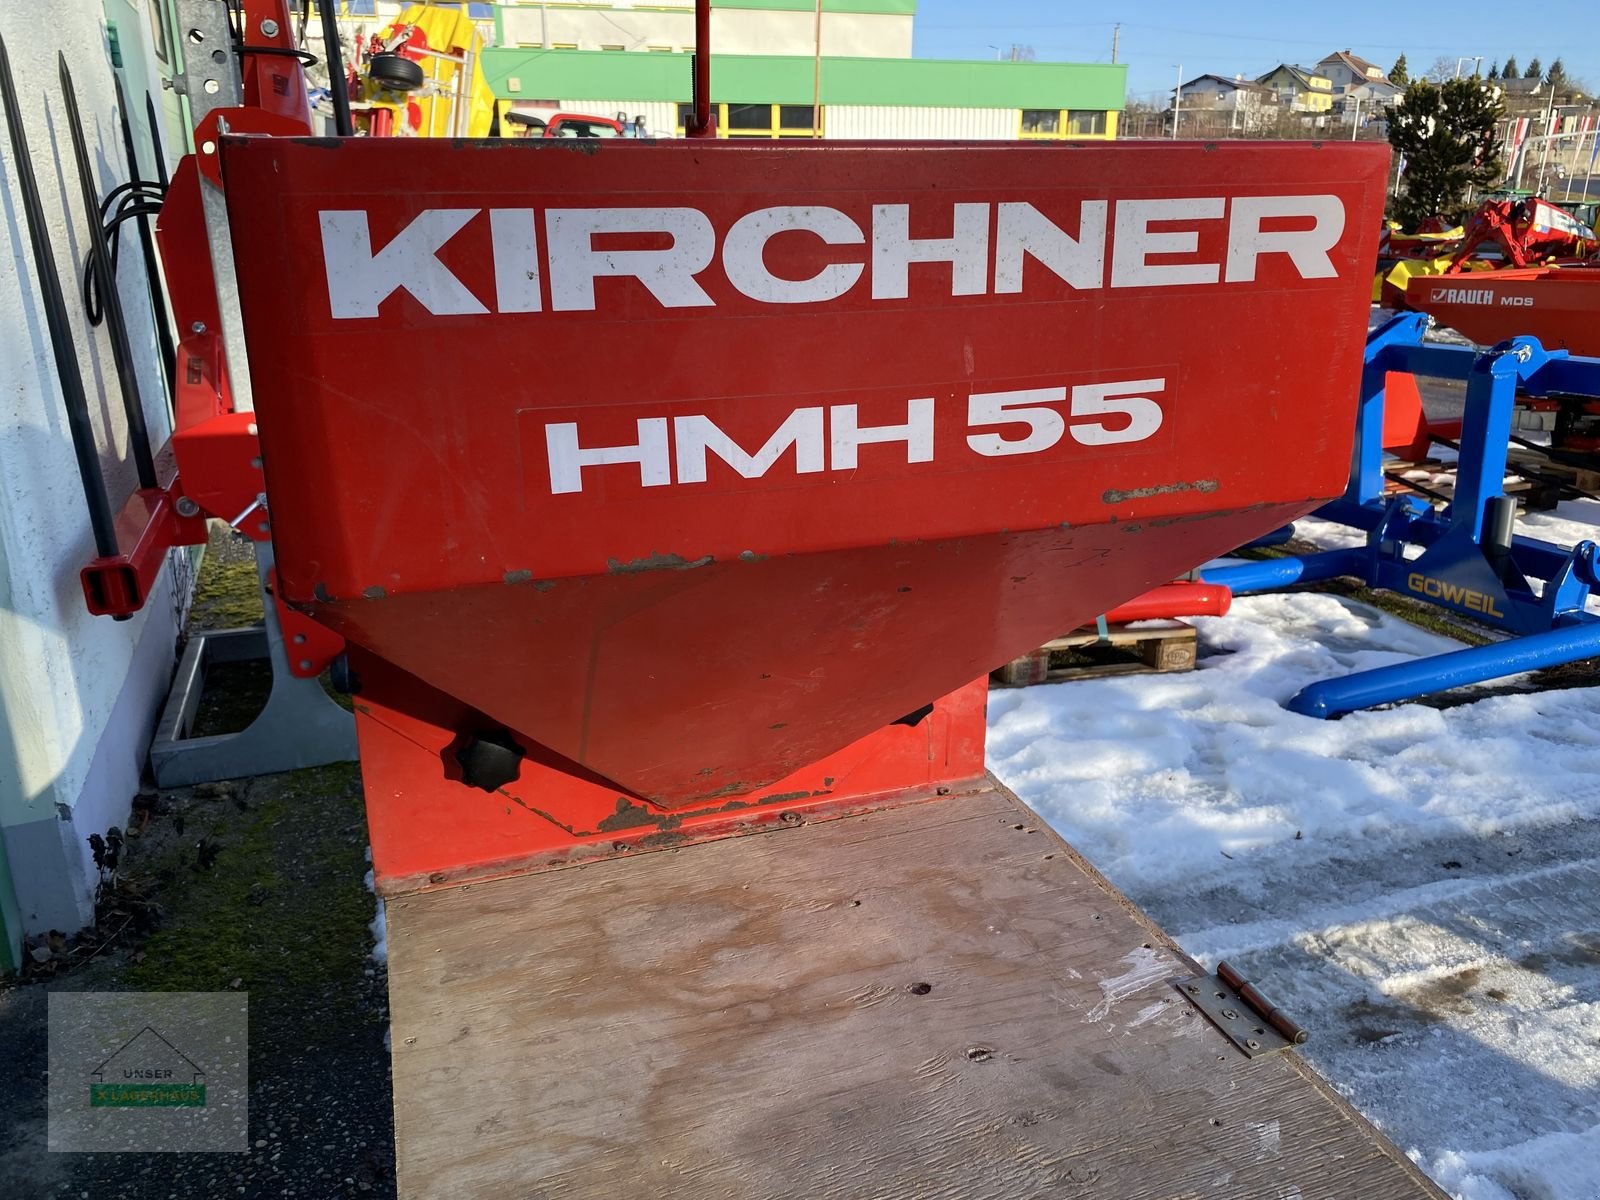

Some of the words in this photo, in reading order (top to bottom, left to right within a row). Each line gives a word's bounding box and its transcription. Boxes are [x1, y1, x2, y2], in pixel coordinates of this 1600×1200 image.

[319, 195, 1347, 320] KIRCHNER
[1447, 289, 1494, 305] RAUCH
[1501, 296, 1534, 307] MDS
[545, 397, 935, 496] HMH
[967, 377, 1167, 458] 55
